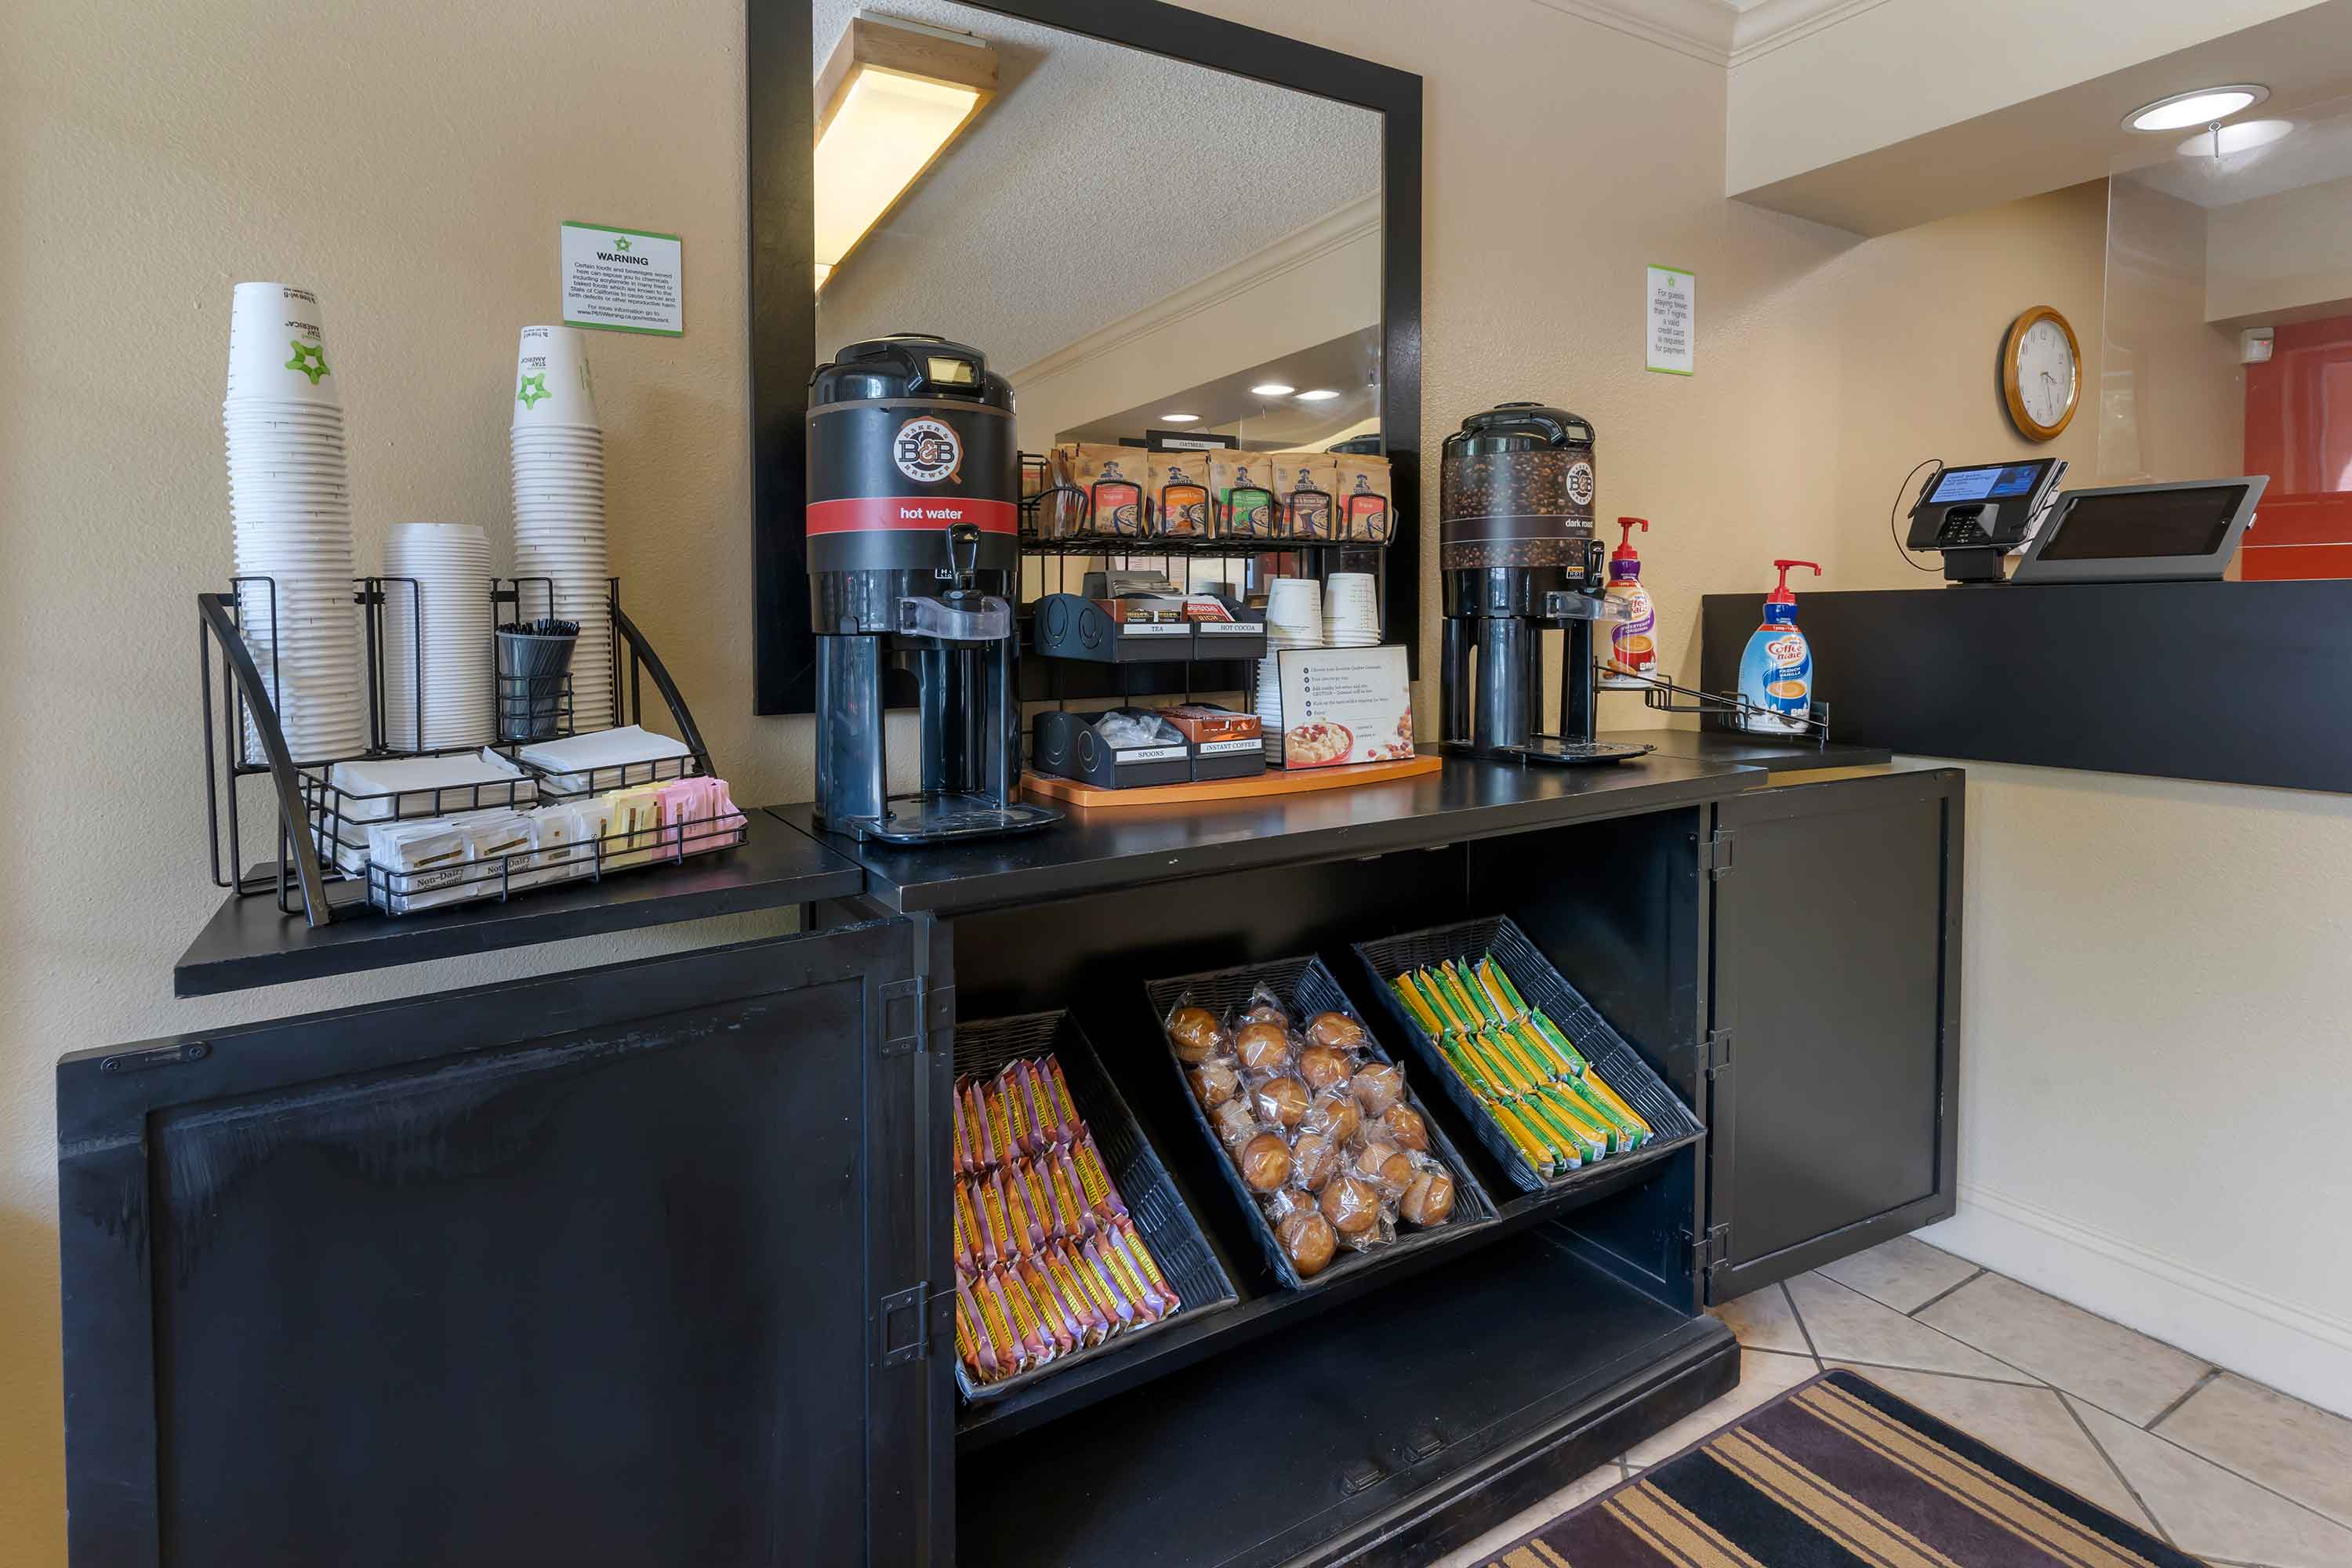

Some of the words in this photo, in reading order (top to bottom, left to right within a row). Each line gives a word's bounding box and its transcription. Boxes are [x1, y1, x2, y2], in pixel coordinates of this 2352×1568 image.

[596, 252, 649, 266] WARNING
[898, 439, 955, 463] B&B
[904, 464, 950, 478] BREWER
[900, 507, 923, 519] hot
[926, 508, 963, 520] water
[1565, 519, 1581, 528] dark
[1138, 750, 1165, 758] SPOONS
[1206, 743, 1232, 752] INSTANT
[416, 868, 464, 887] Non-Dairy
[1031, 1081, 1041, 1104] NATURE
[1037, 1102, 1047, 1127] VALLEY
[1076, 1157, 1090, 1183] NATURE
[1084, 1180, 1099, 1207] VALLEY
[1127, 1236, 1145, 1261] NATURE
[1140, 1258, 1159, 1283] VALLEY
